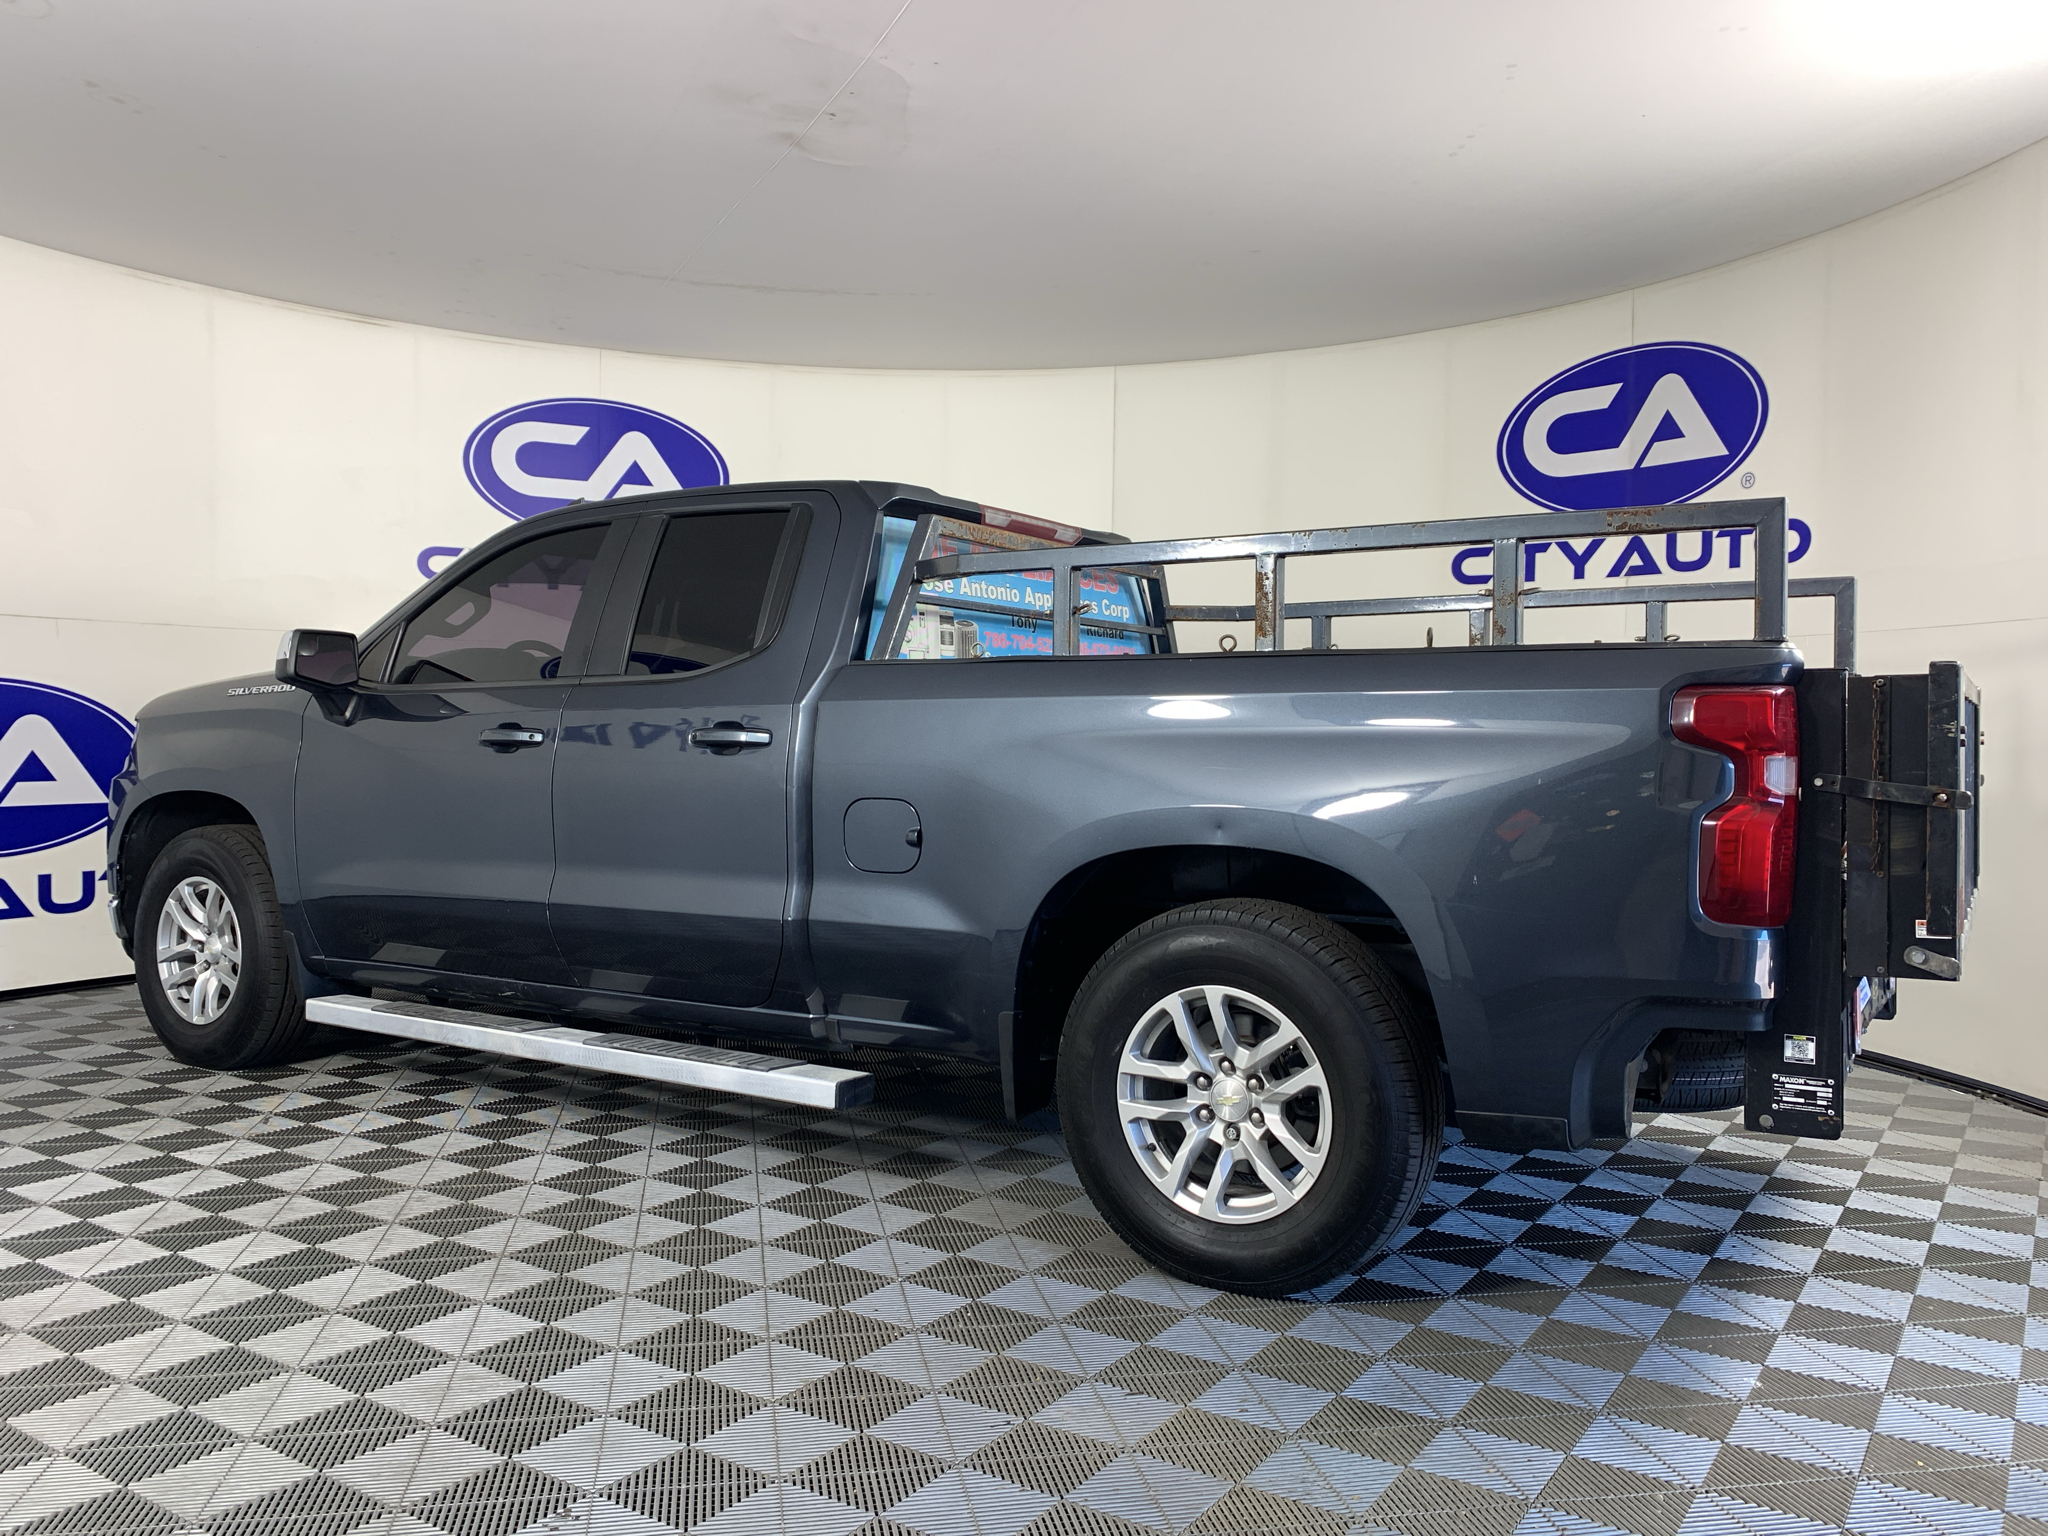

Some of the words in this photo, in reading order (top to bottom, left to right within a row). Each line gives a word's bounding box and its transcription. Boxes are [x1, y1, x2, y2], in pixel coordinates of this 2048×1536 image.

[1523, 373, 1730, 478] CA
[491, 421, 683, 502] CA
[1451, 518, 1812, 585] CTYAUT
[923, 577, 955, 593] ose
[959, 577, 1020, 603] Antonio
[1101, 598, 1130, 622] Corp
[984, 631, 1053, 653] 786-704-52
[1010, 616, 1038, 633] Tony
[1086, 627, 1125, 640] Richard
[226, 684, 297, 697] SILVERADO
[0, 713, 110, 807] A
[1779, 1076, 1805, 1085] MAXON
